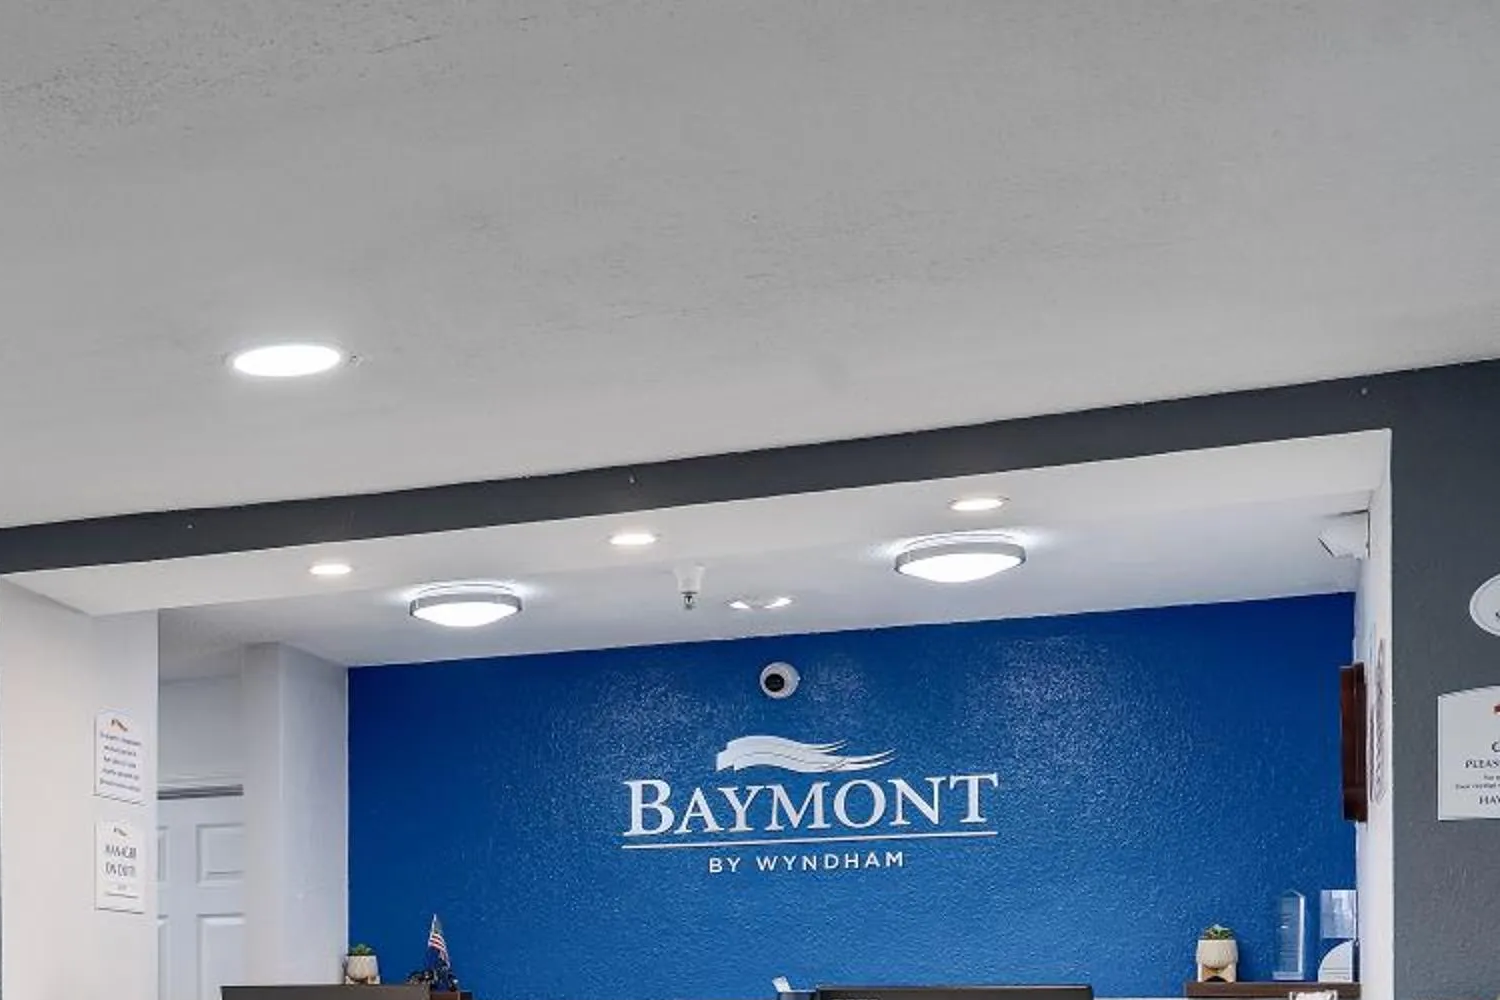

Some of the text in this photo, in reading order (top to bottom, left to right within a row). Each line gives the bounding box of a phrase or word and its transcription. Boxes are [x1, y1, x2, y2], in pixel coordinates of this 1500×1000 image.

[622, 772, 999, 838] BAYMONT
[708, 850, 904, 874] BY WYNDHAM
